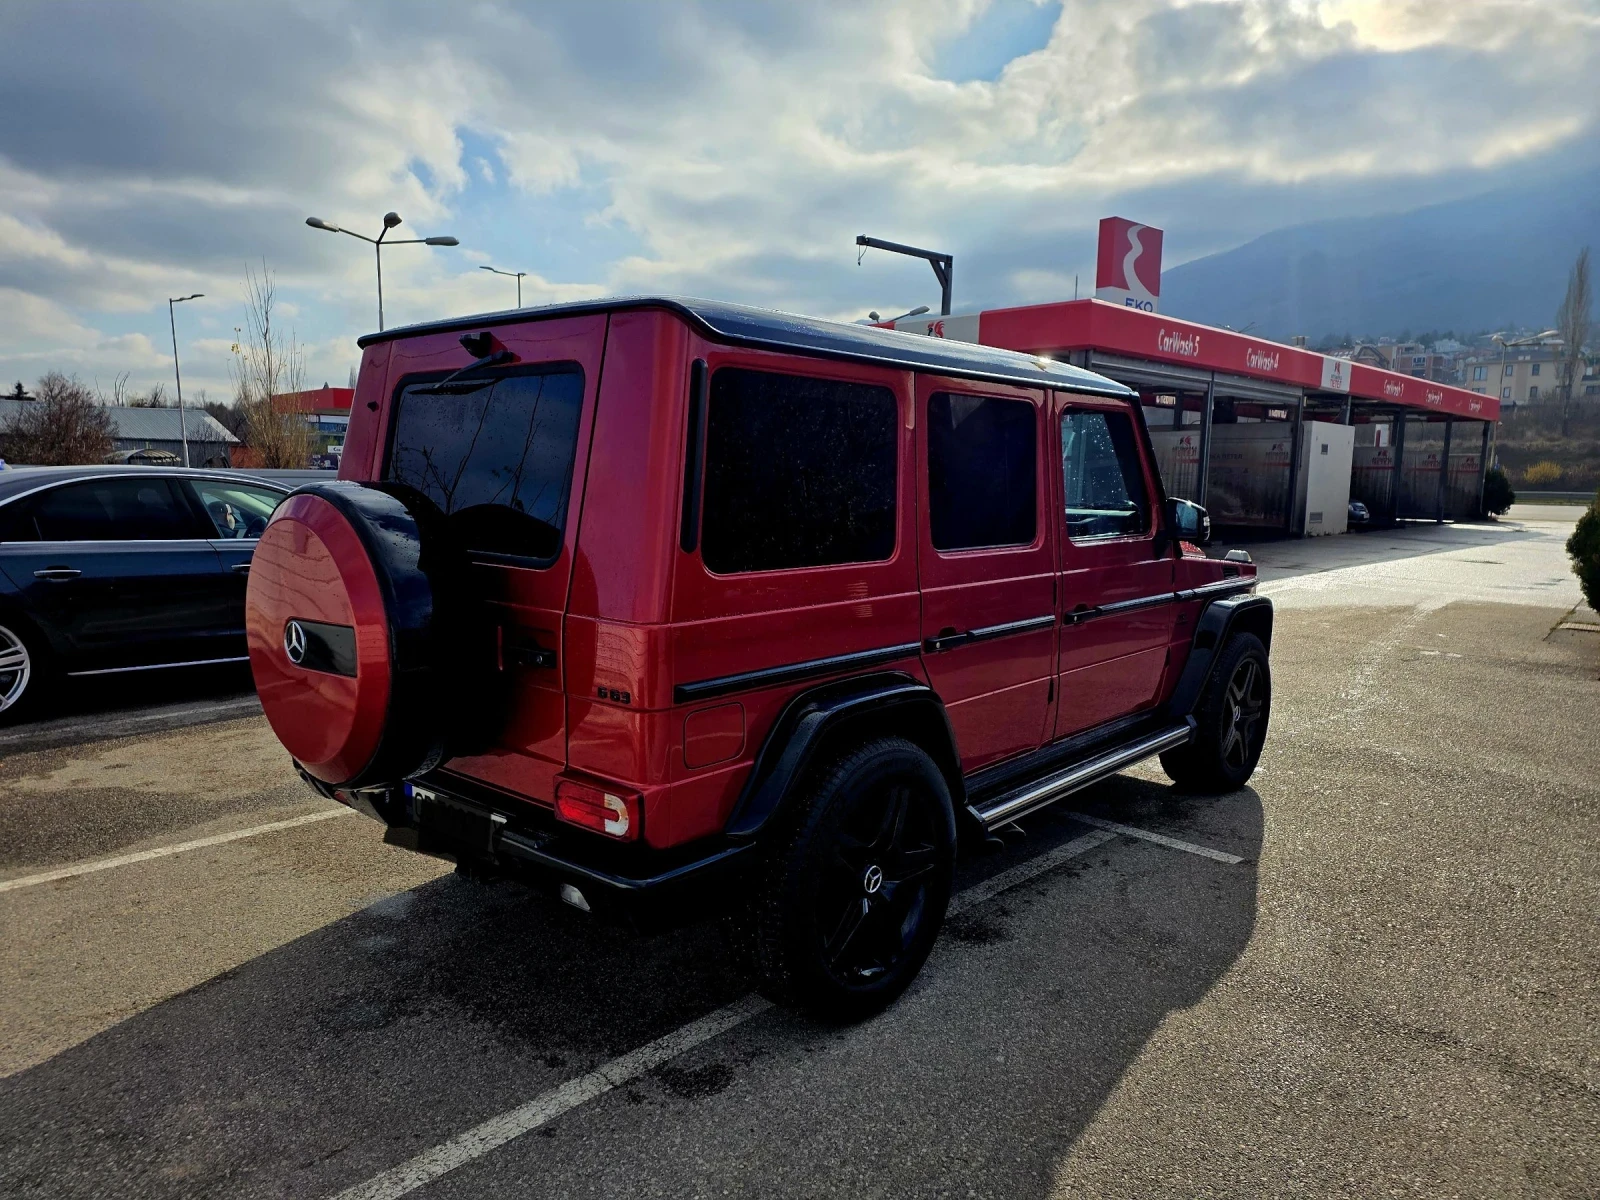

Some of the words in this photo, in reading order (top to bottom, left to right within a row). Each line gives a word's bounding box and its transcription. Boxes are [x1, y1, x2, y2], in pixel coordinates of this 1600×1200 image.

[1125, 298, 1153, 312] EKO
[1158, 329, 1193, 356] CarWash
[1193, 336, 1200, 357] 5
[1274, 353, 1280, 370] 4
